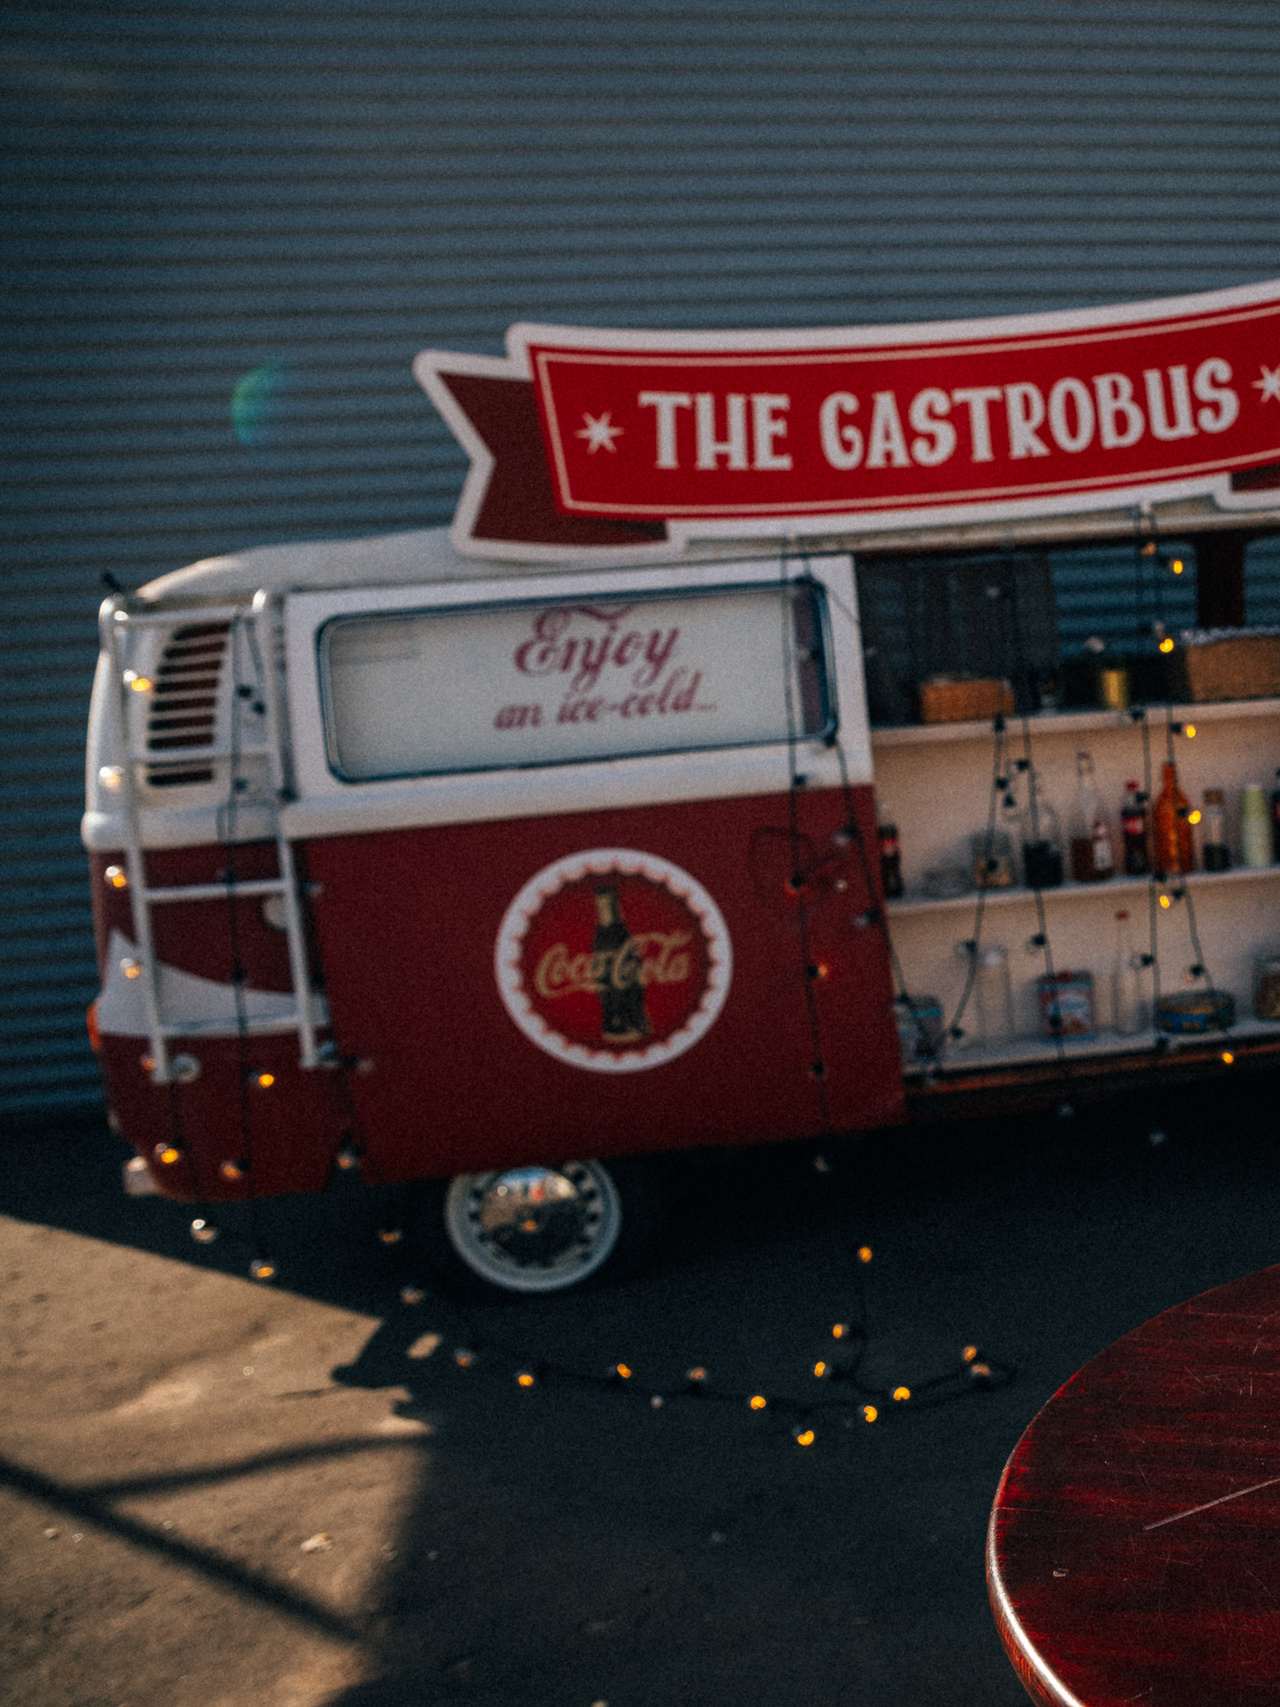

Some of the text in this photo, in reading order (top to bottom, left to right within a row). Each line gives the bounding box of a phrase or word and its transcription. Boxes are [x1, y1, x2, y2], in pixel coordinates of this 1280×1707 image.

[637, 355, 1241, 472] THE GASTROBUS
[513, 604, 681, 699] Enjoy
[493, 703, 542, 731] an
